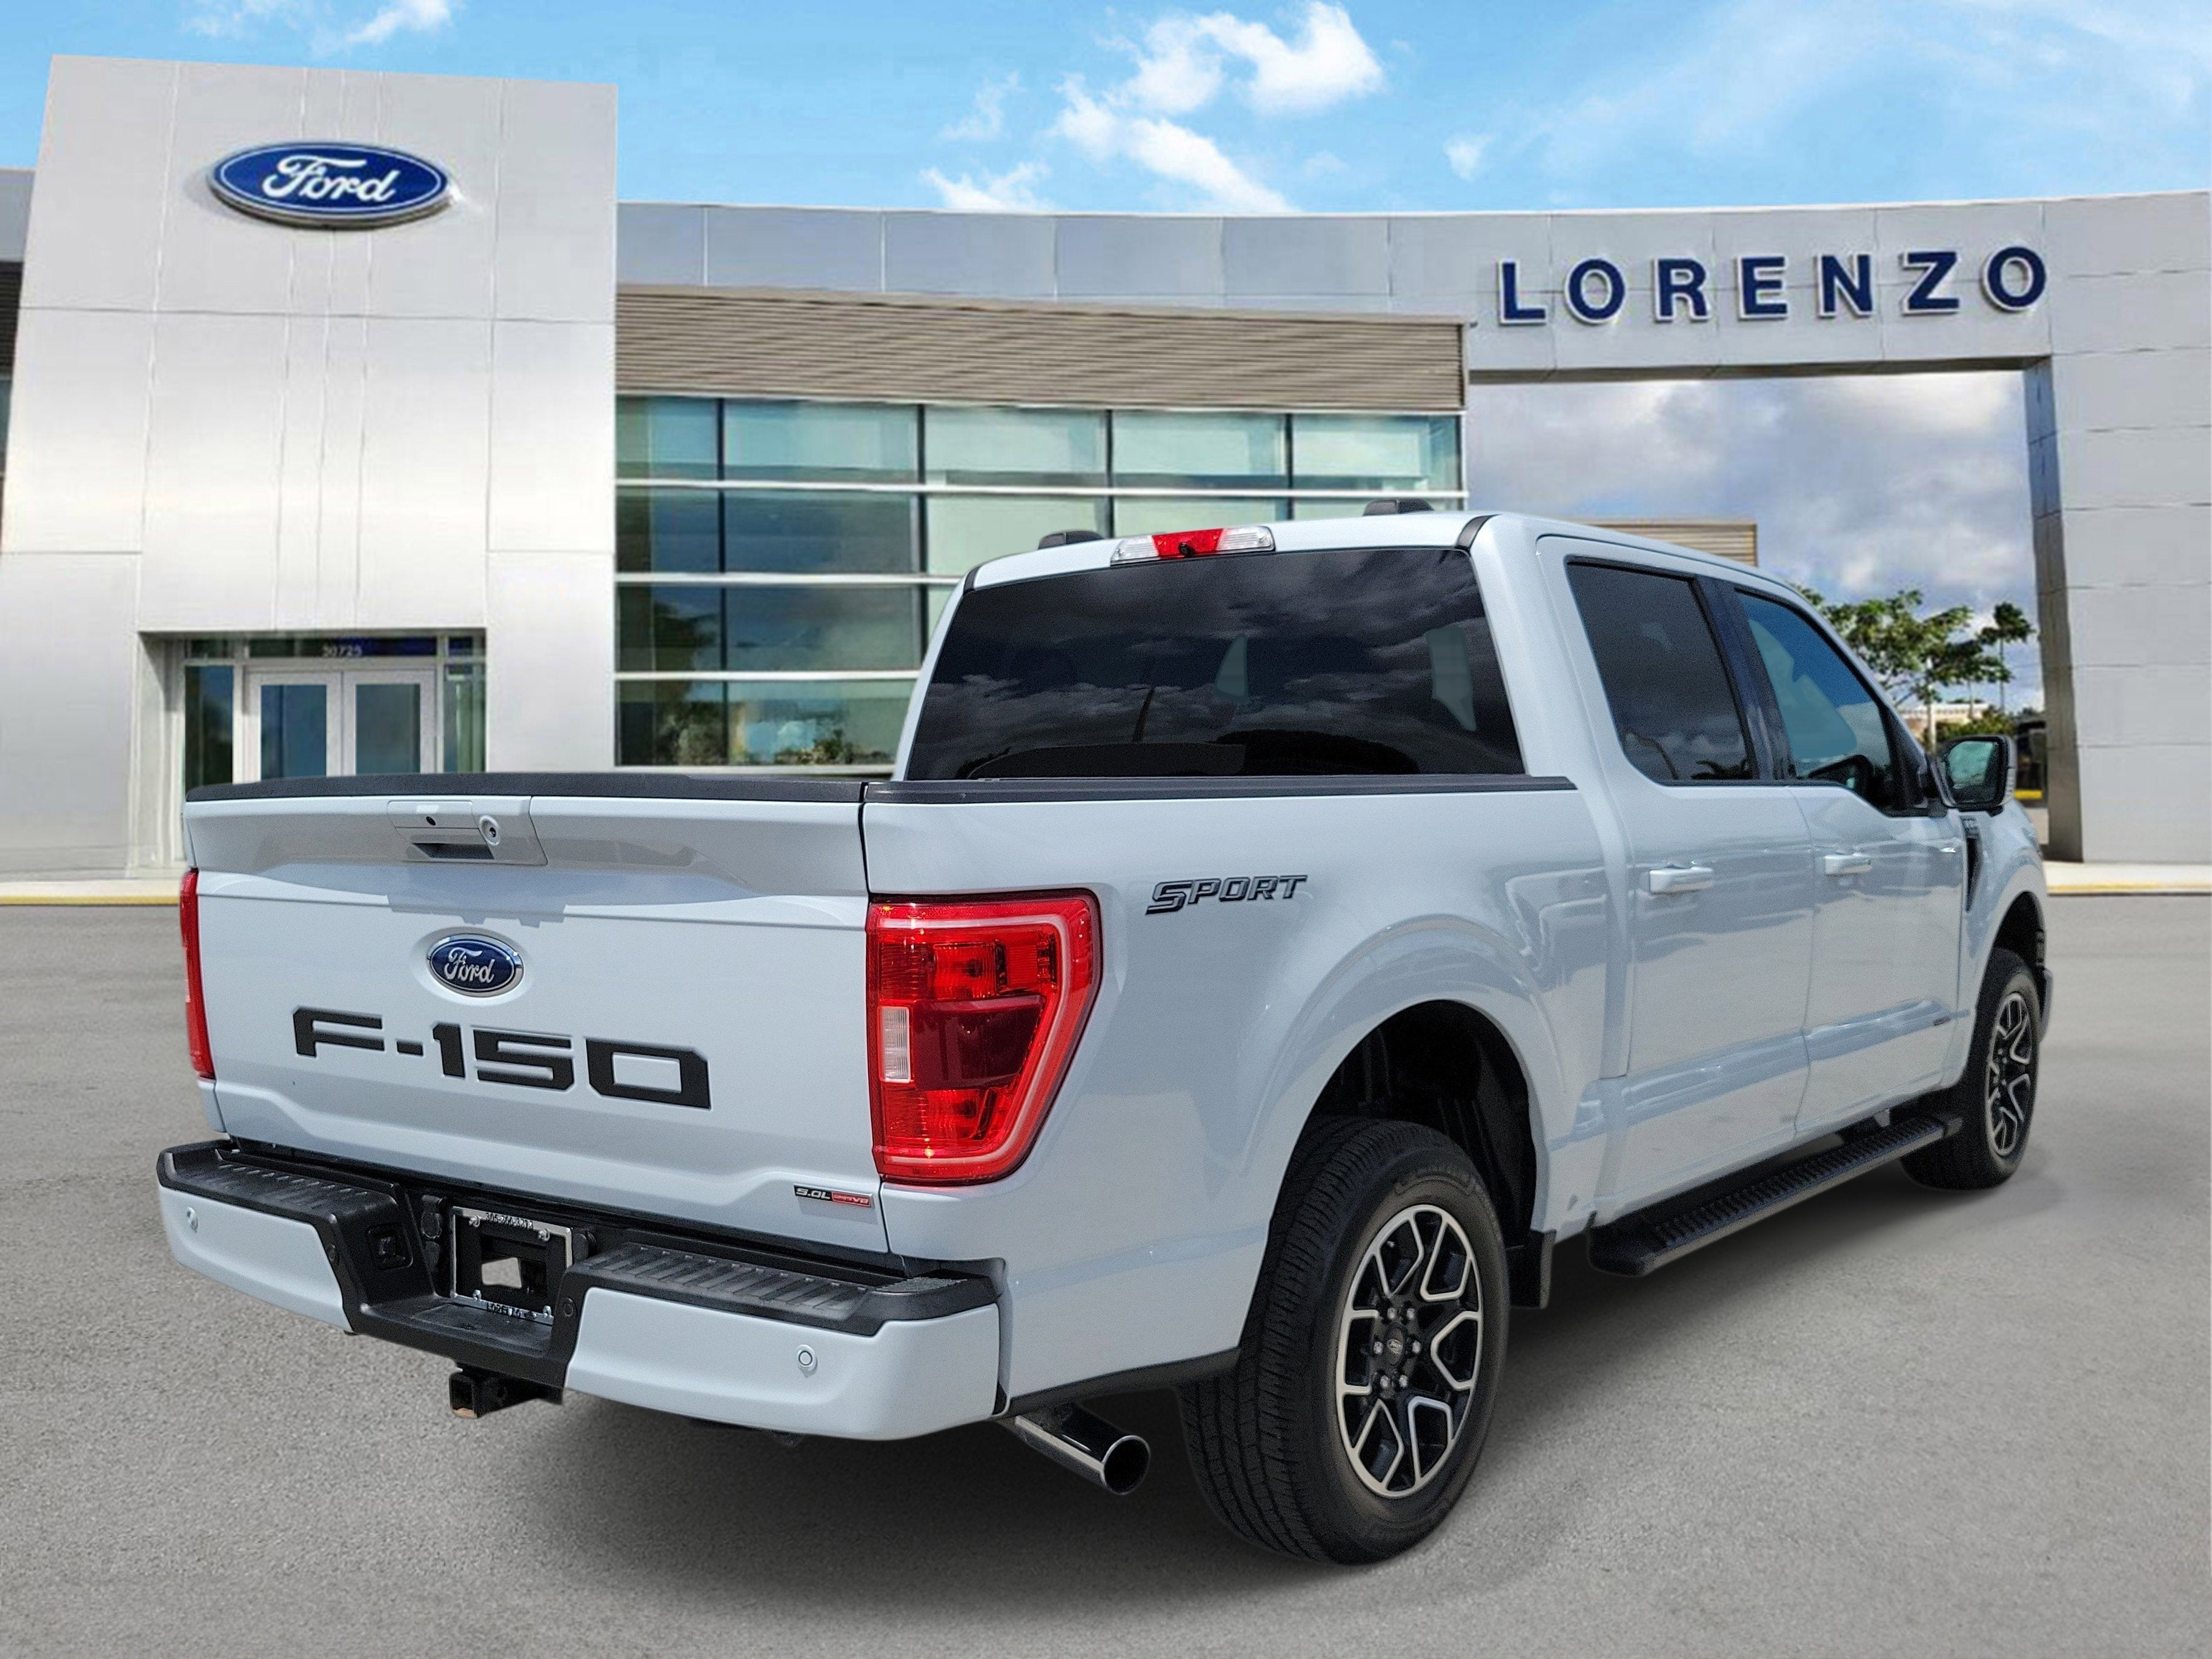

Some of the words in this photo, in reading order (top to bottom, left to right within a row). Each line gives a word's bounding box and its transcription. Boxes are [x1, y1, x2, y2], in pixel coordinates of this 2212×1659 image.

[262, 154, 399, 202] Ford
[1498, 246, 2047, 324] LORENZO
[1145, 875, 1308, 915] SPORT
[443, 946, 494, 985] Ford
[293, 1006, 711, 1109] F-150
[795, 1187, 831, 1200] 5.0L
